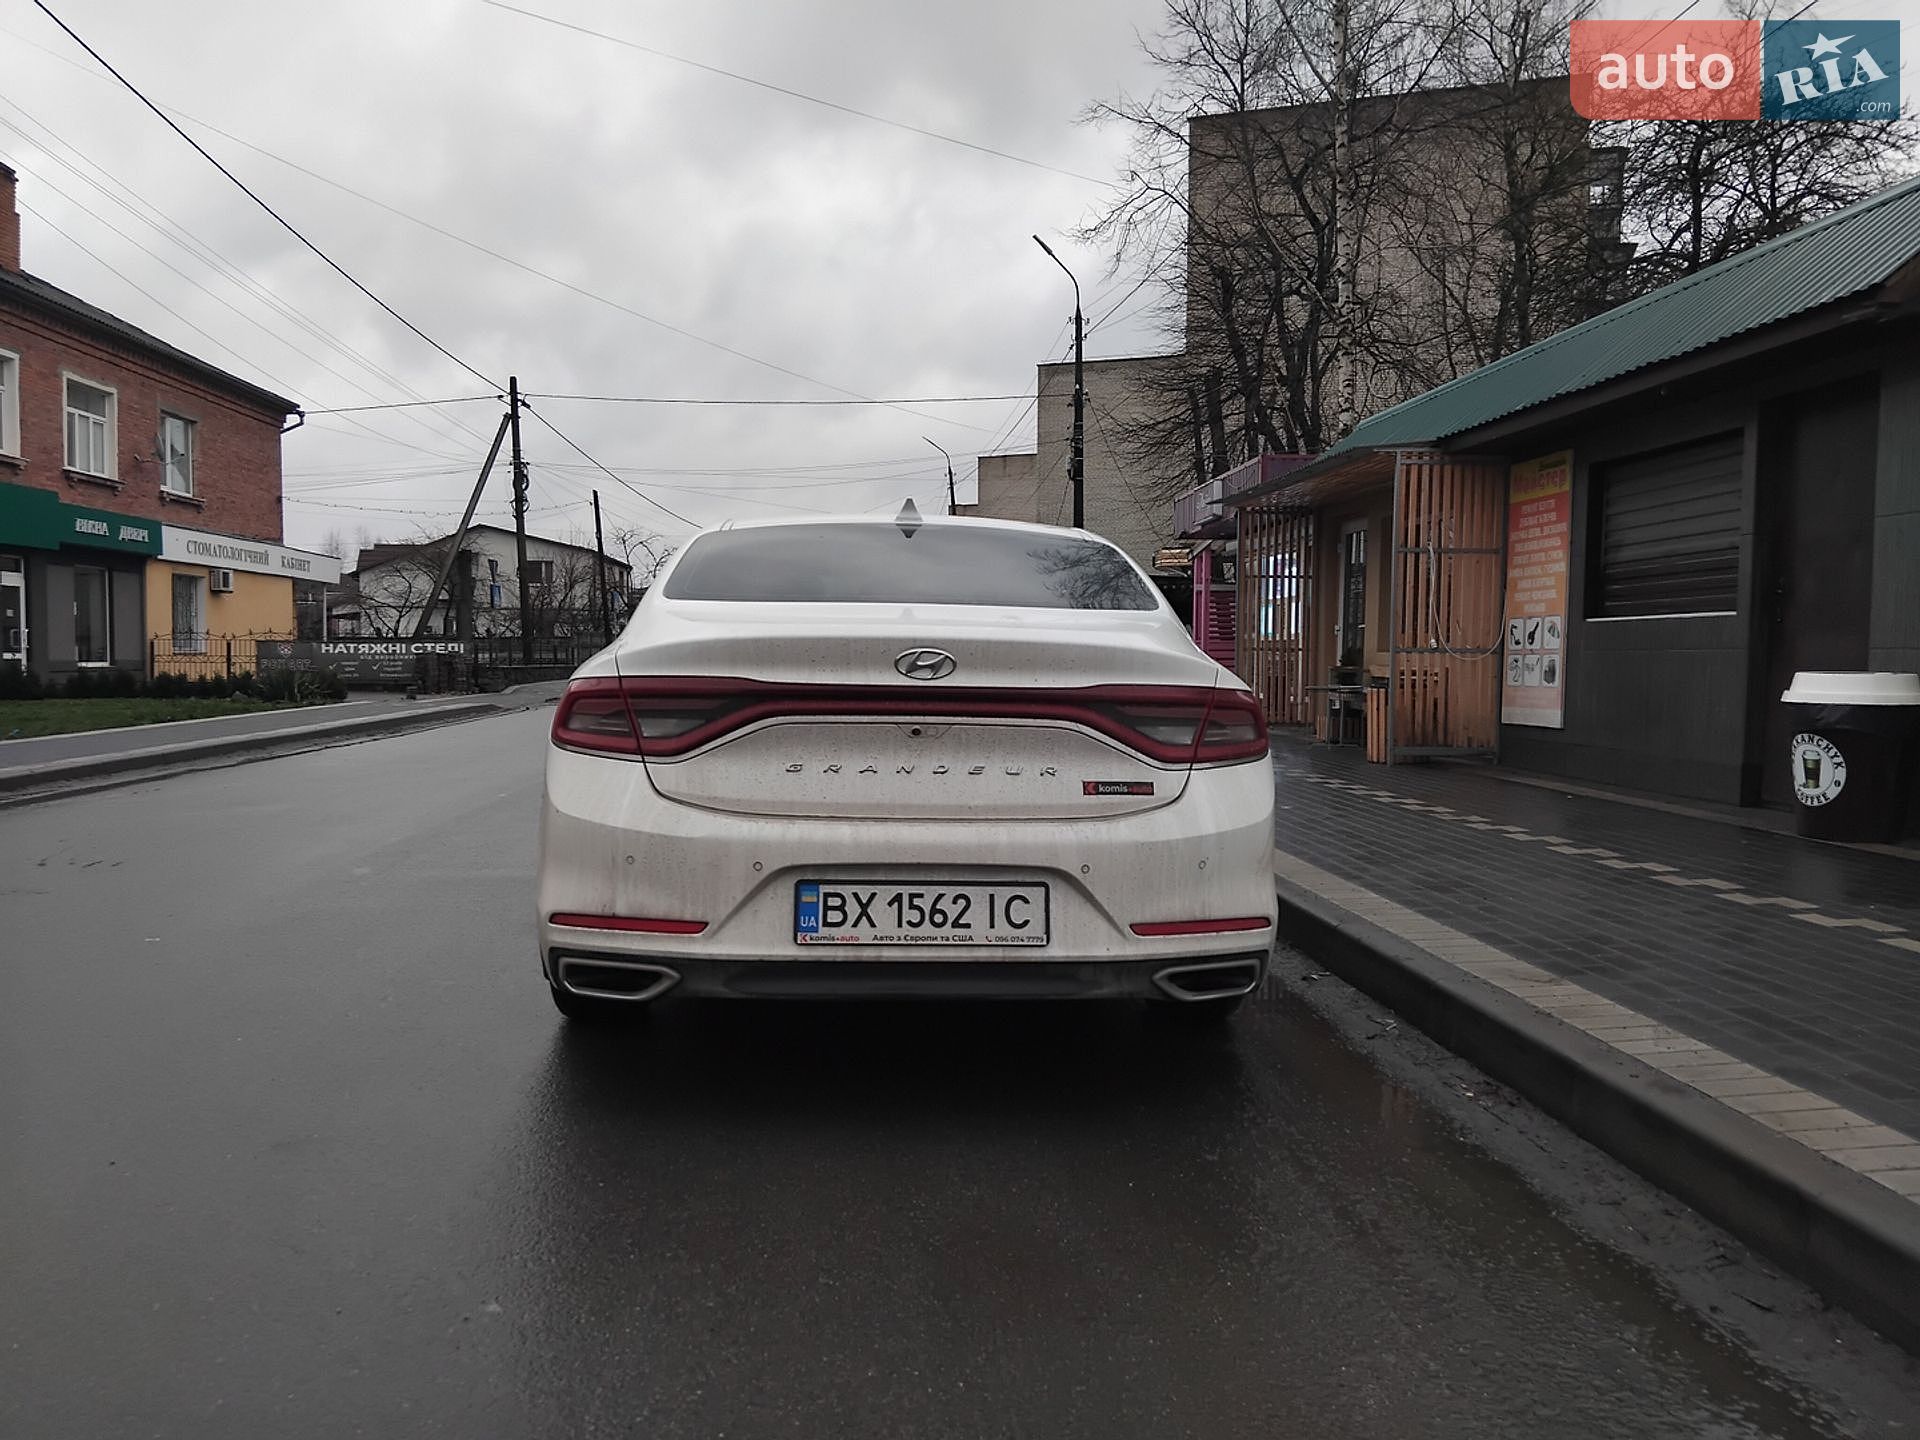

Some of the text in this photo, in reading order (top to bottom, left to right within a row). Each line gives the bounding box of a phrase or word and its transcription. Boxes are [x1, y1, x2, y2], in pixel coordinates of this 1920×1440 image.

[186, 539, 311, 573] СТОМАТОЛОГІЧНИЙ КАБІНЕТ
[321, 642, 407, 655] НАТЯЖНІ
[785, 763, 1058, 777] GRANDEUR
[821, 891, 1031, 930] BX 1562 IC
[800, 915, 817, 928] UA
[872, 934, 895, 942] Авто
[952, 934, 975, 942] США
